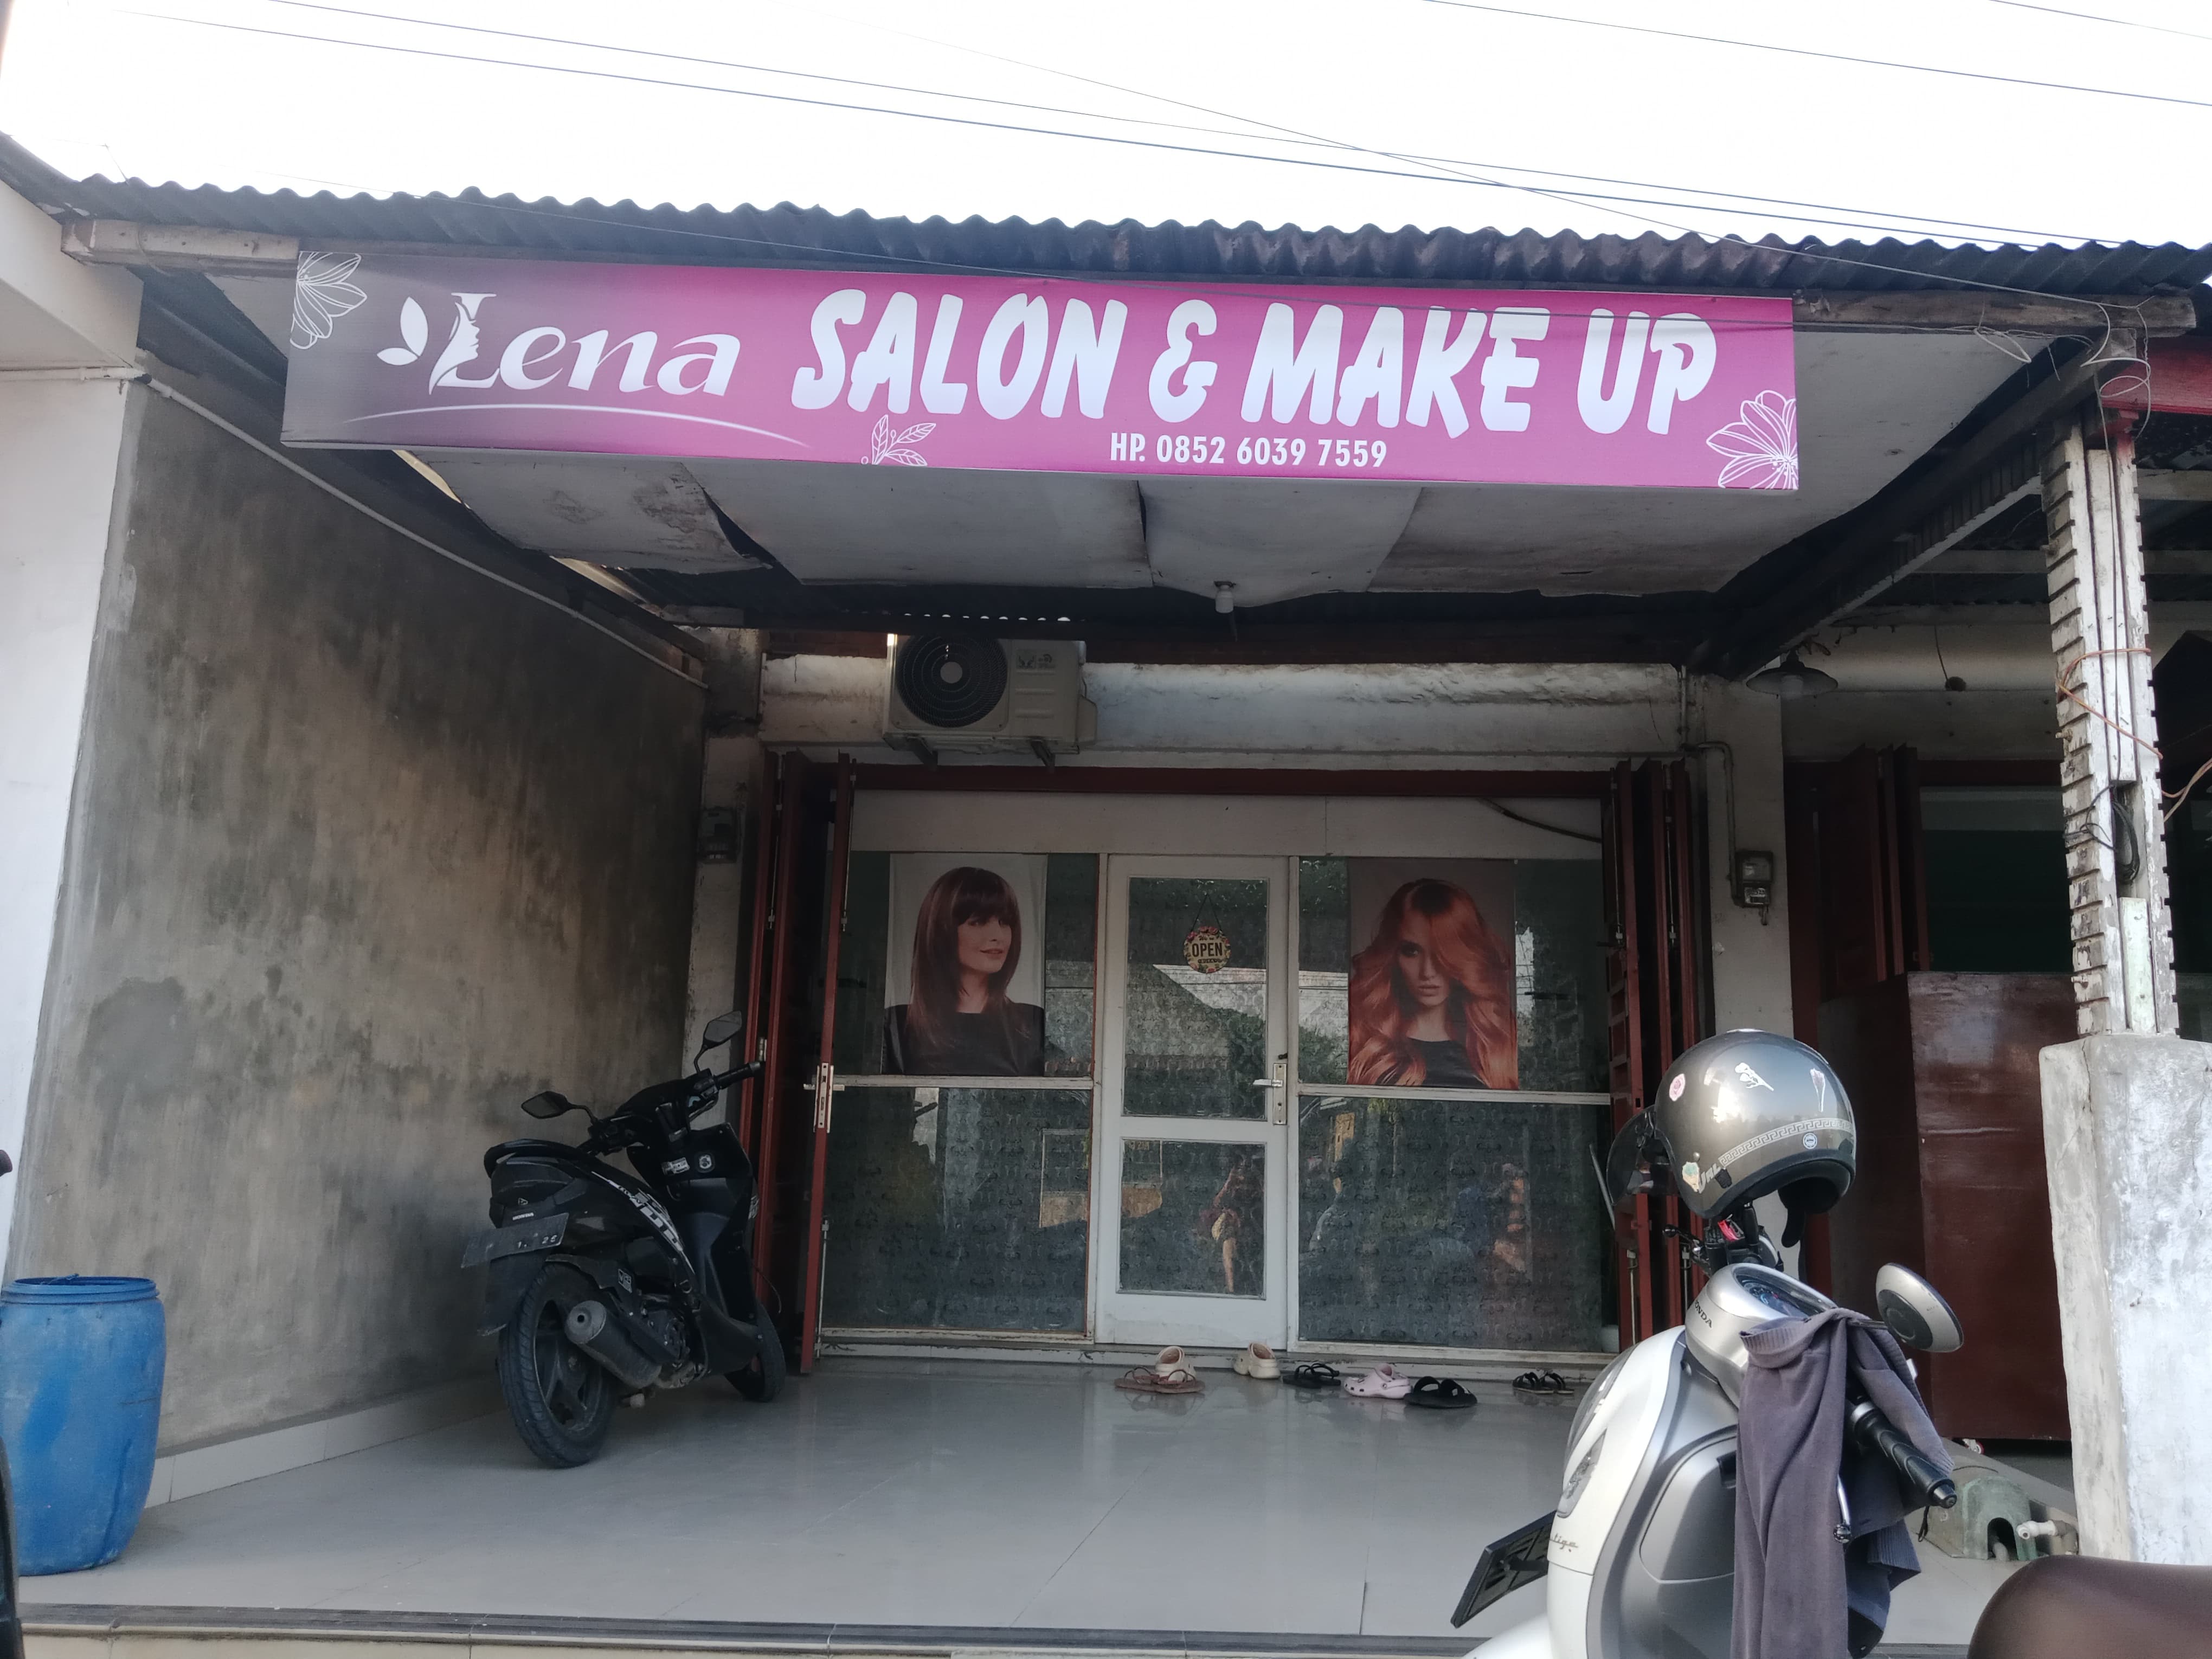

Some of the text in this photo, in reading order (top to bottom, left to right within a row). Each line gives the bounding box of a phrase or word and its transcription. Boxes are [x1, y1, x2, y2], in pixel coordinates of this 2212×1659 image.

[428, 289, 1717, 439] Lena SALON & MAKE UP
[1110, 432, 1387, 467] HP. 0852 6039 7559
[1192, 942, 1223, 957] OPEN
[1694, 1298, 1713, 1329] ONDA
